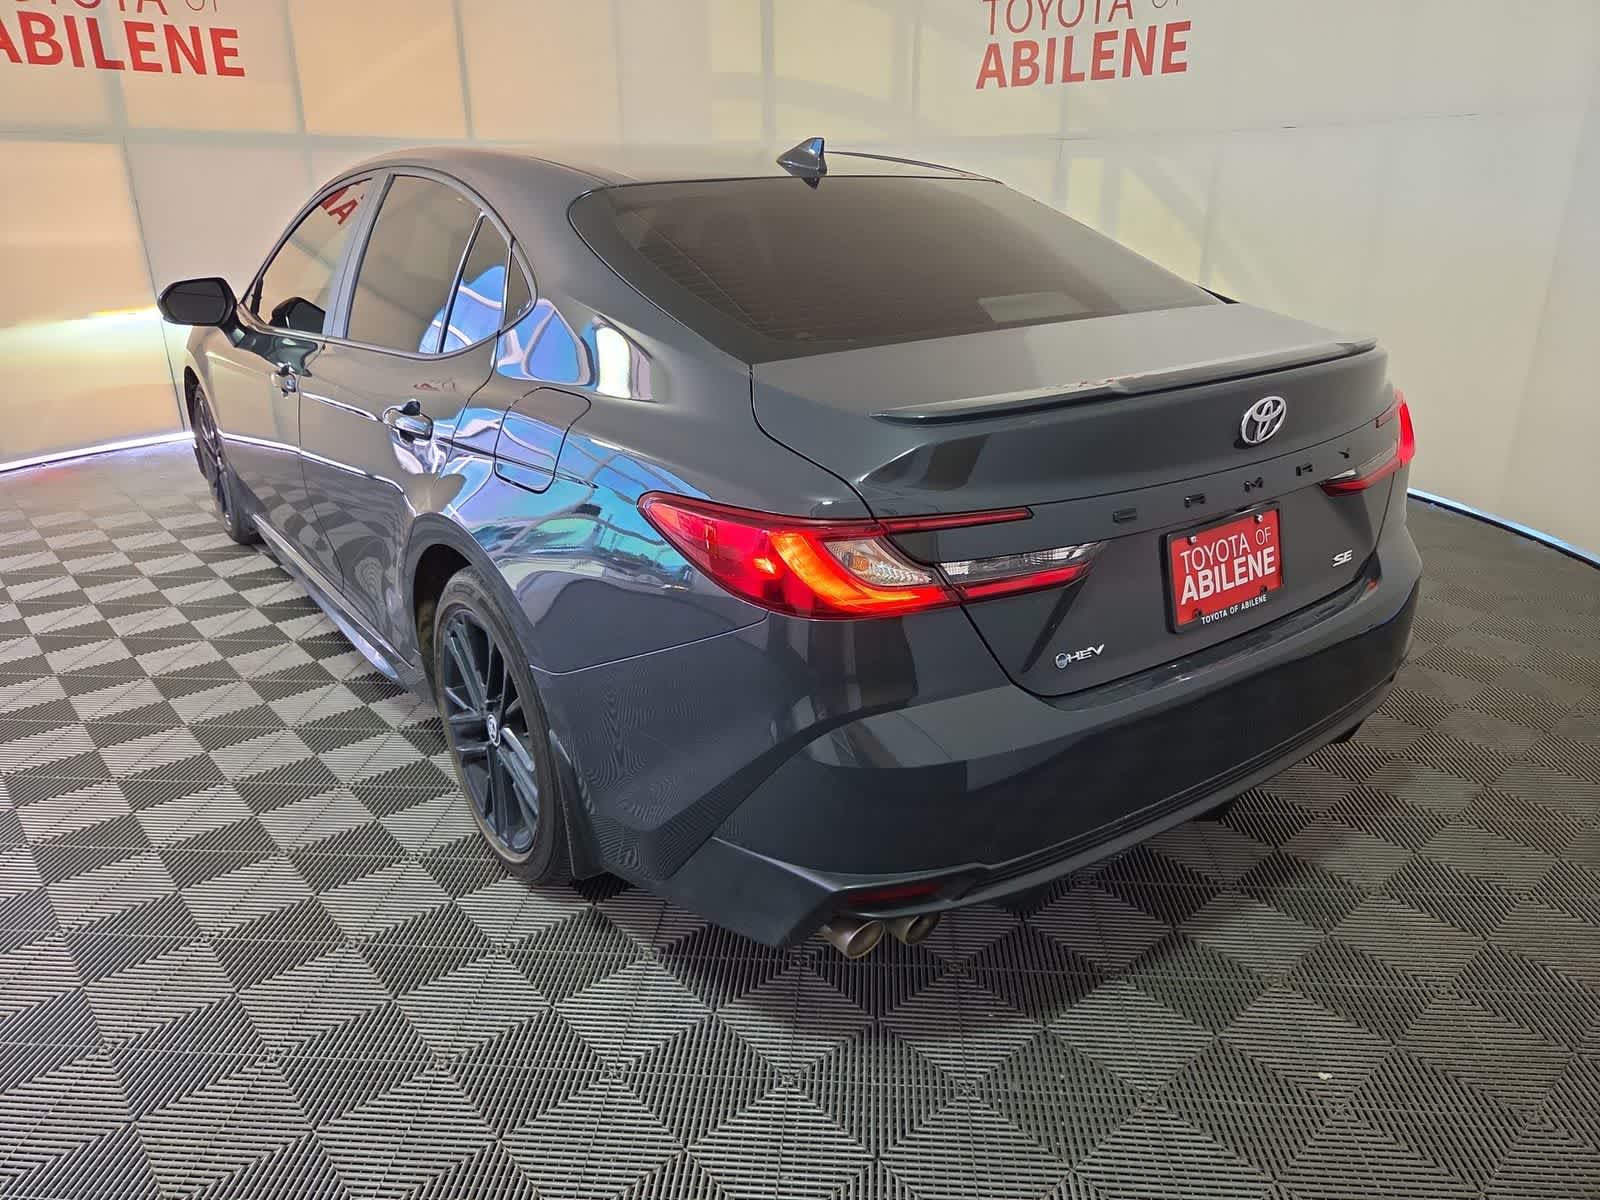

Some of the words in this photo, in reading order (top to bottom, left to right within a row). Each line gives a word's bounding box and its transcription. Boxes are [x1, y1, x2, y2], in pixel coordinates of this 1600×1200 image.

[983, 0, 1134, 35] TOYOTA
[975, 20, 1192, 90] ABILENE
[1180, 532, 1250, 574] TOYOTA
[1255, 526, 1272, 545] OF
[1332, 549, 1353, 567] SE
[1180, 546, 1276, 605] ABILENE
[1201, 609, 1228, 625] TOYOTA
[1229, 604, 1239, 615] OF
[1241, 594, 1268, 611] ABILENE
[1066, 643, 1105, 663] HEV
